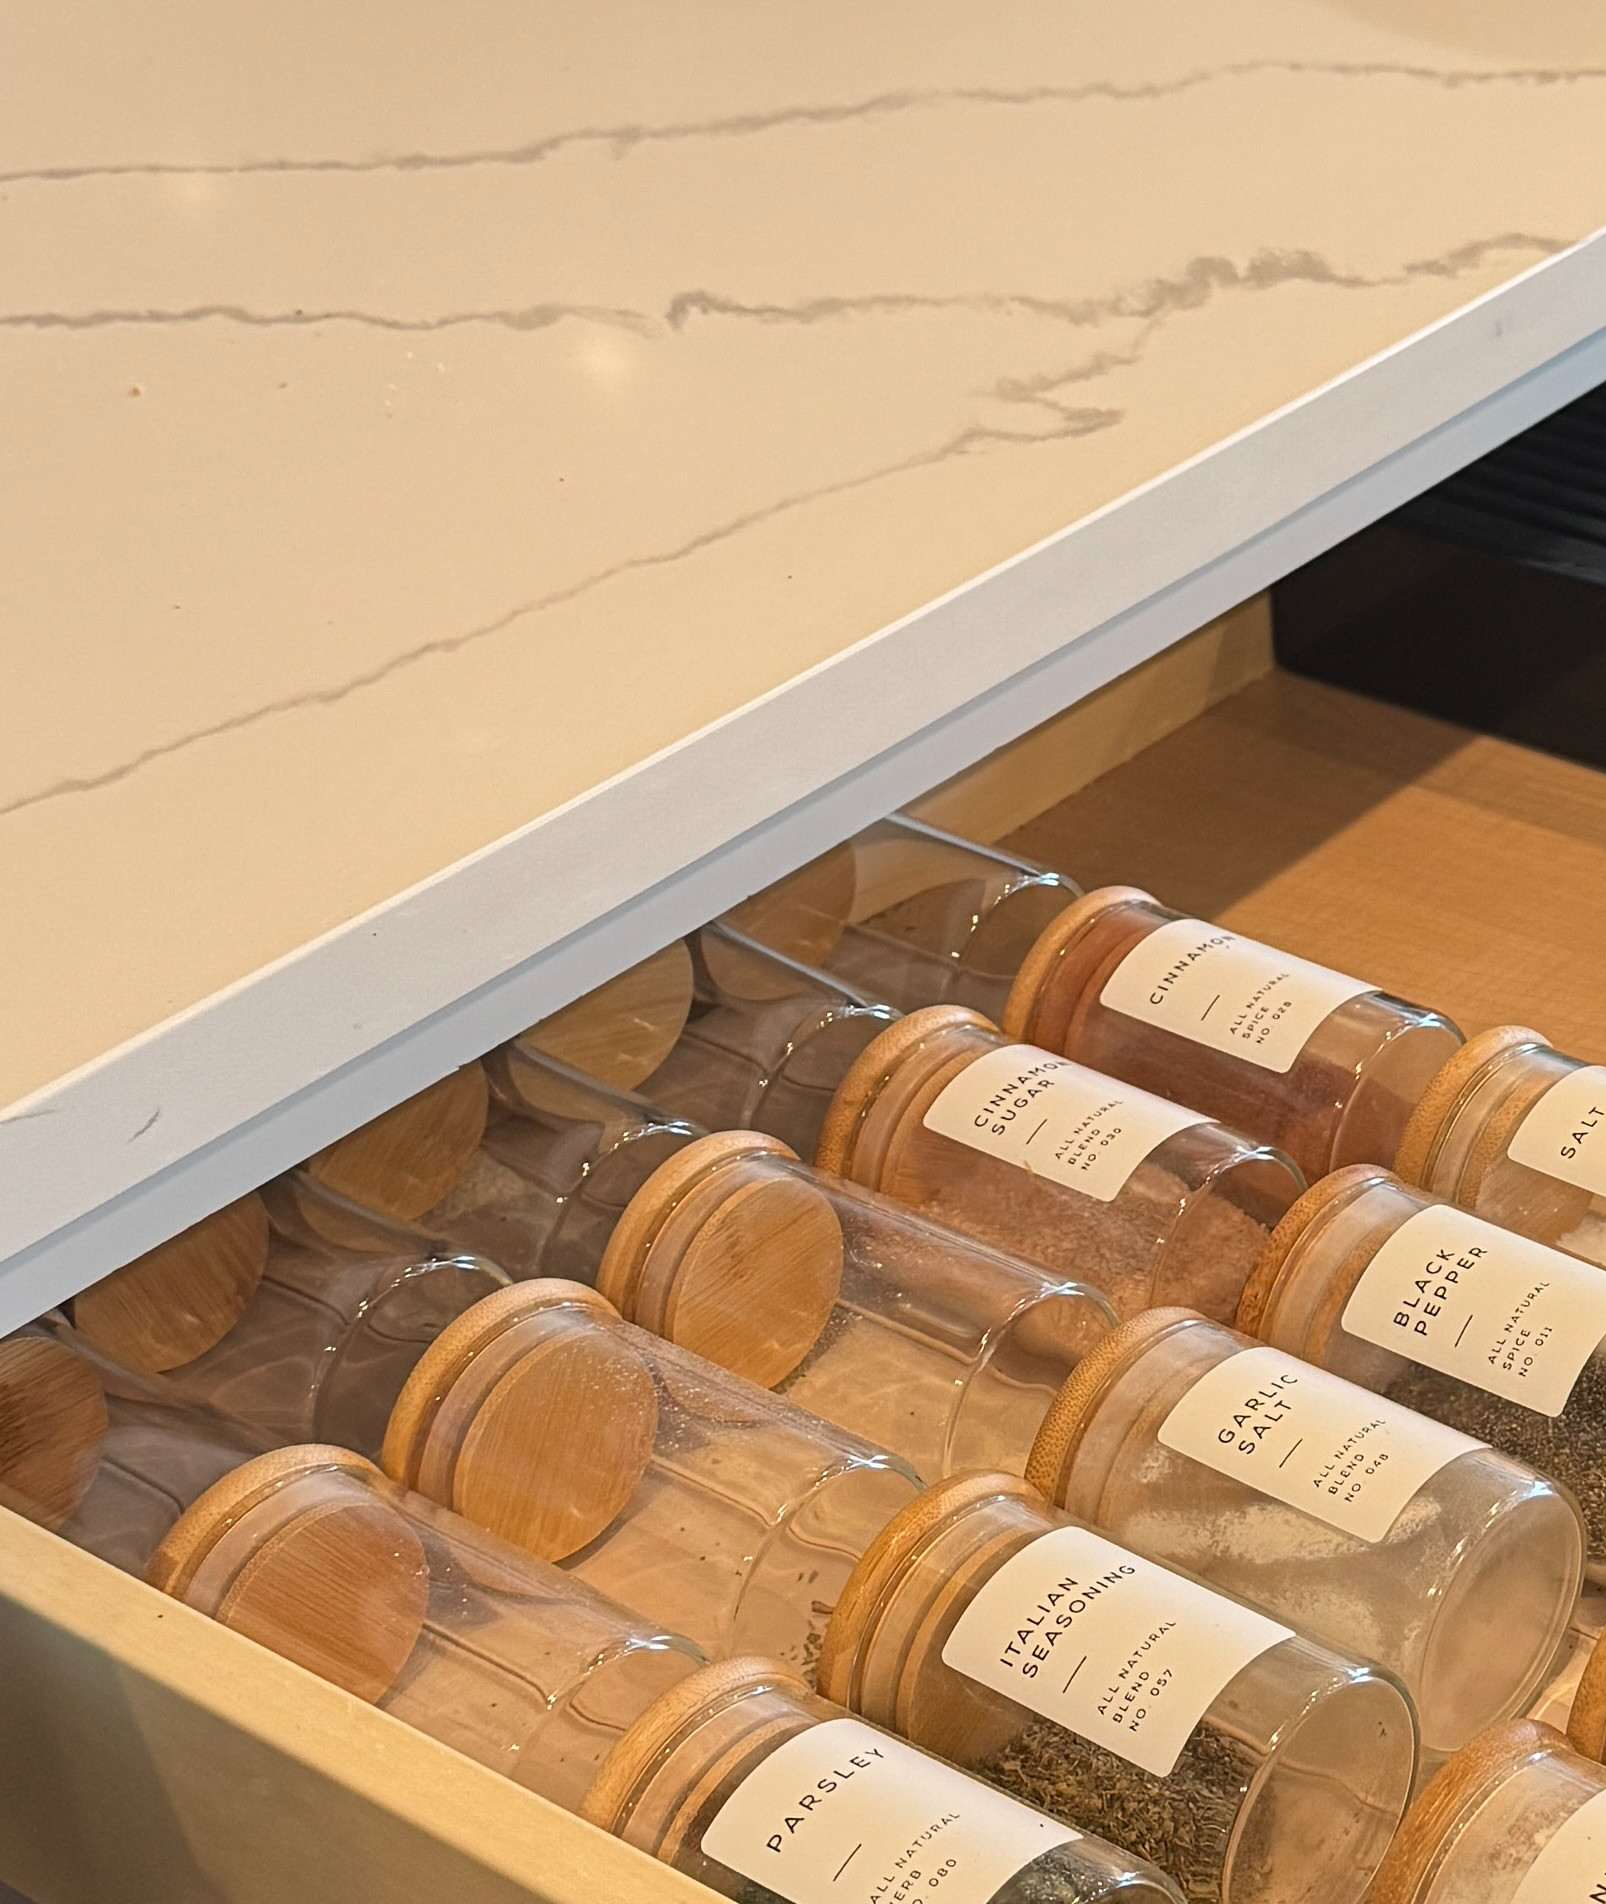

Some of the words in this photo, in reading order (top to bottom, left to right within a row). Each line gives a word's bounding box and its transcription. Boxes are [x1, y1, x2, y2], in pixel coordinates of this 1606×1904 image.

[1150, 935, 1236, 1005] CINNAMON
[1230, 1013, 1247, 1034] ALL
[1247, 971, 1290, 1009] NATURAL
[1242, 1006, 1269, 1039] SPICE
[974, 1060, 1069, 1128] CINNAMON
[992, 1079, 1055, 1136] SUGAR
[1055, 1139, 1074, 1159] ALL
[1076, 1099, 1124, 1135] NATURAL
[1068, 1128, 1101, 1165] BLEND
[1100, 1127, 1122, 1147] 030
[1561, 1106, 1605, 1159] SALT
[1393, 1248, 1455, 1327] BLACK
[1414, 1246, 1488, 1336] PEPPER
[1488, 1339, 1507, 1365] ALL
[1504, 1281, 1550, 1332] NATURAL
[1503, 1329, 1531, 1370] SPICE
[1535, 1326, 1553, 1346] 011
[1218, 1374, 1298, 1444] GARLIC
[1238, 1399, 1292, 1454] SALT
[1313, 1464, 1335, 1488] ALL
[1335, 1419, 1386, 1459] NATURAL
[1328, 1454, 1364, 1496] BLEND
[1366, 1453, 1389, 1476] 048
[1000, 1577, 1079, 1668] ITALIAN
[1022, 1564, 1136, 1678] SEASONING
[1098, 1683, 1120, 1716] ALL
[1119, 1621, 1177, 1679] NATURAL
[1113, 1670, 1150, 1724] BLEND
[1150, 1668, 1174, 1697] 057
[766, 1747, 885, 1853] PARSLEY
[870, 1873, 895, 1904] ALL
[895, 1811, 960, 1869] NATURAL
[928, 1858, 957, 1888] 080
